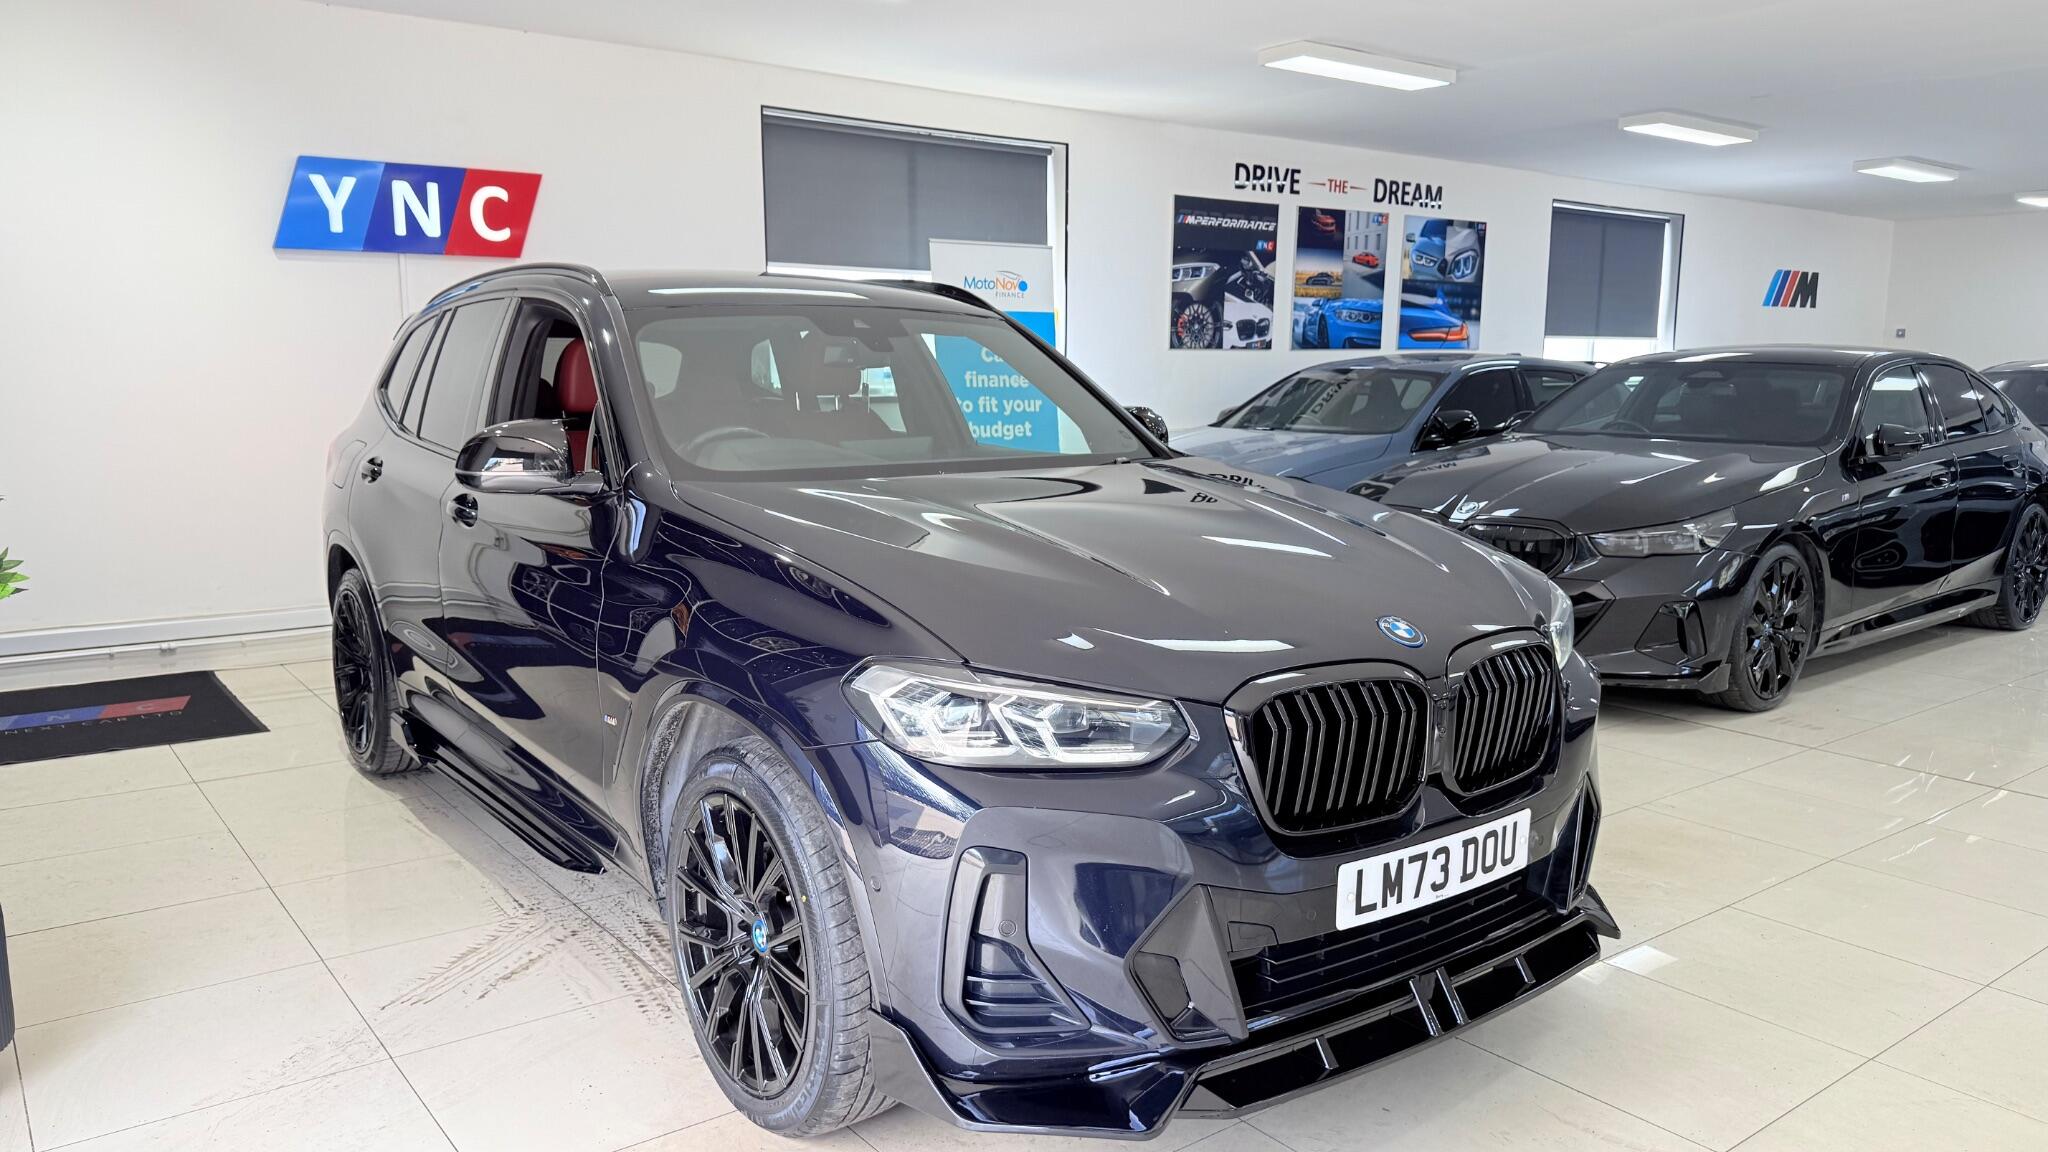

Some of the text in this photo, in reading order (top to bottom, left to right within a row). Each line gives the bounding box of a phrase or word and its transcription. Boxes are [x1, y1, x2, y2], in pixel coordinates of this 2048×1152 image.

[1234, 162, 1443, 209] DRIVE THE DREAM
[308, 173, 511, 242] YNC
[965, 370, 1029, 388] finance
[979, 395, 998, 413] fit
[1003, 399, 1042, 416] your
[968, 420, 1032, 440] budget
[1355, 820, 1518, 916] LM73 DOU
